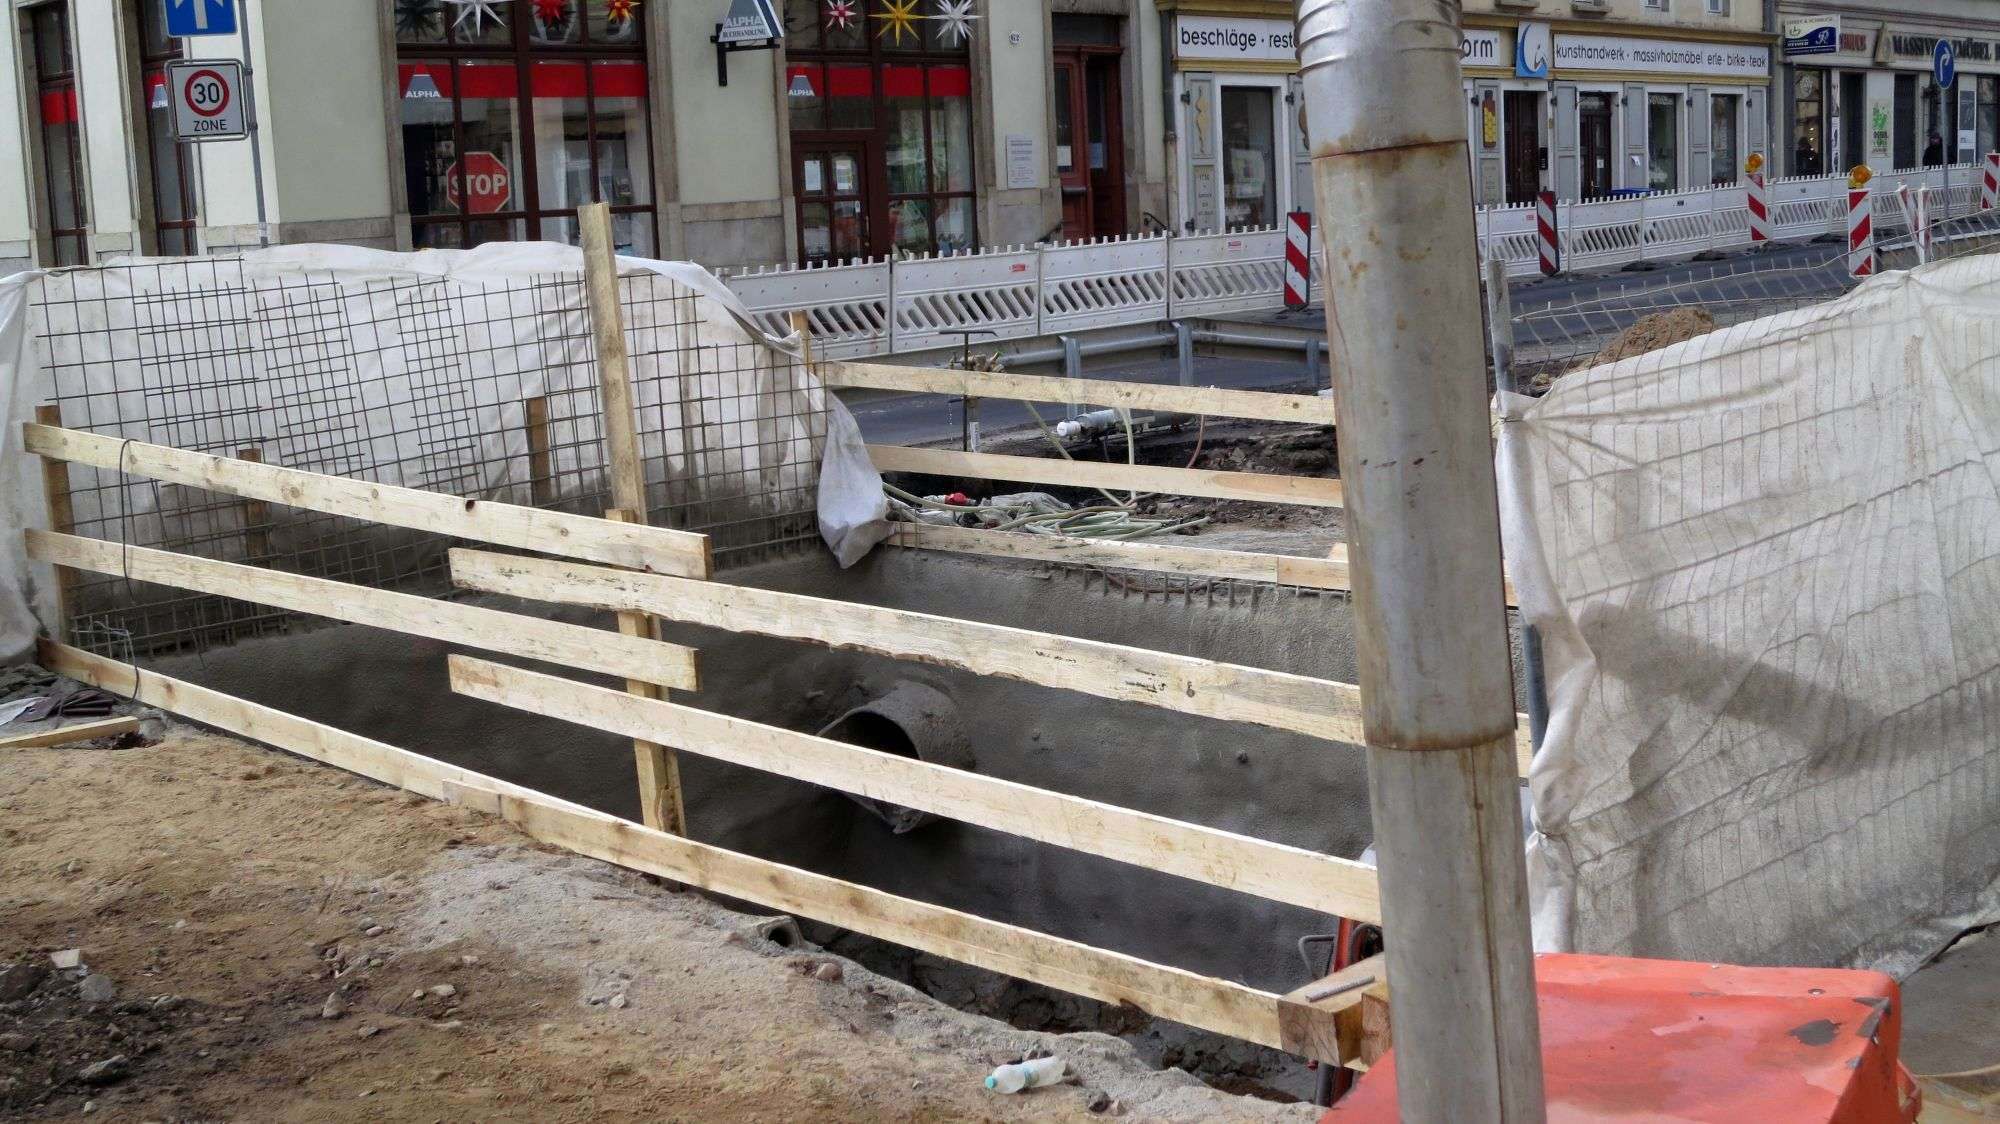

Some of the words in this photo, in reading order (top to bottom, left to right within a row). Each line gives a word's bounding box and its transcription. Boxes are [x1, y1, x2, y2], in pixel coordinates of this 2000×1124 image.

[726, 16, 763, 26] ALPHA
[1181, 27, 1256, 51] beschläge
[1556, 43, 1625, 60] kunsthandwerk
[1632, 47, 1703, 64] massivholzmöbel
[1707, 52, 1723, 65] erle
[1726, 53, 1746, 67] birke
[1749, 55, 1766, 68] teak
[193, 83, 220, 104] 30
[405, 90, 441, 98] ALPHA
[193, 119, 227, 132] ZONE
[451, 174, 506, 196] STOP
